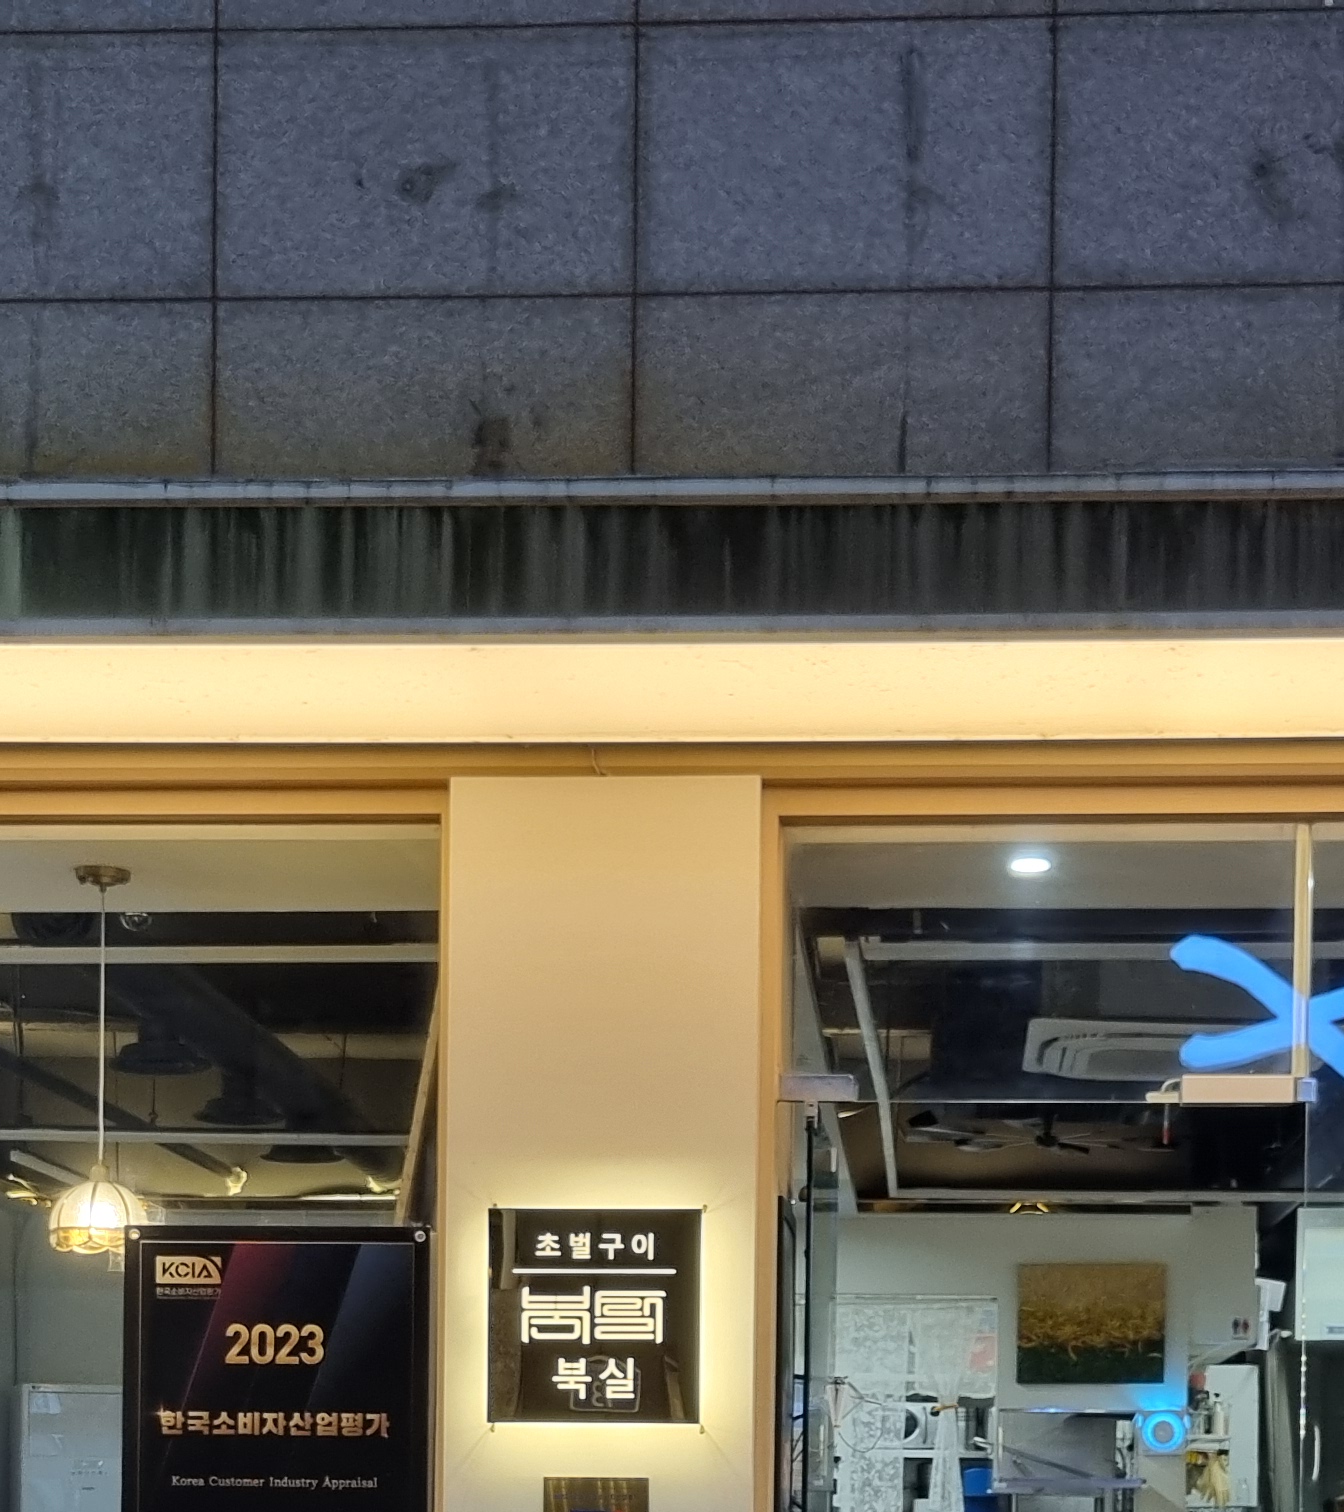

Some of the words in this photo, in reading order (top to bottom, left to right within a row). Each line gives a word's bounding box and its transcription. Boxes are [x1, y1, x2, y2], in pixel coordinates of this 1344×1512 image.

[535, 1231, 656, 1262] 초벌구이
[161, 1261, 213, 1279] KCIA
[224, 1323, 325, 1365] 2023
[552, 1356, 636, 1400] 북실
[159, 1410, 390, 1438] 한국소비자산업평가
[171, 1475, 205, 1488] Korea
[208, 1475, 264, 1488] Customer
[269, 1476, 318, 1491] Industry
[322, 1476, 378, 1490] Appraisal
